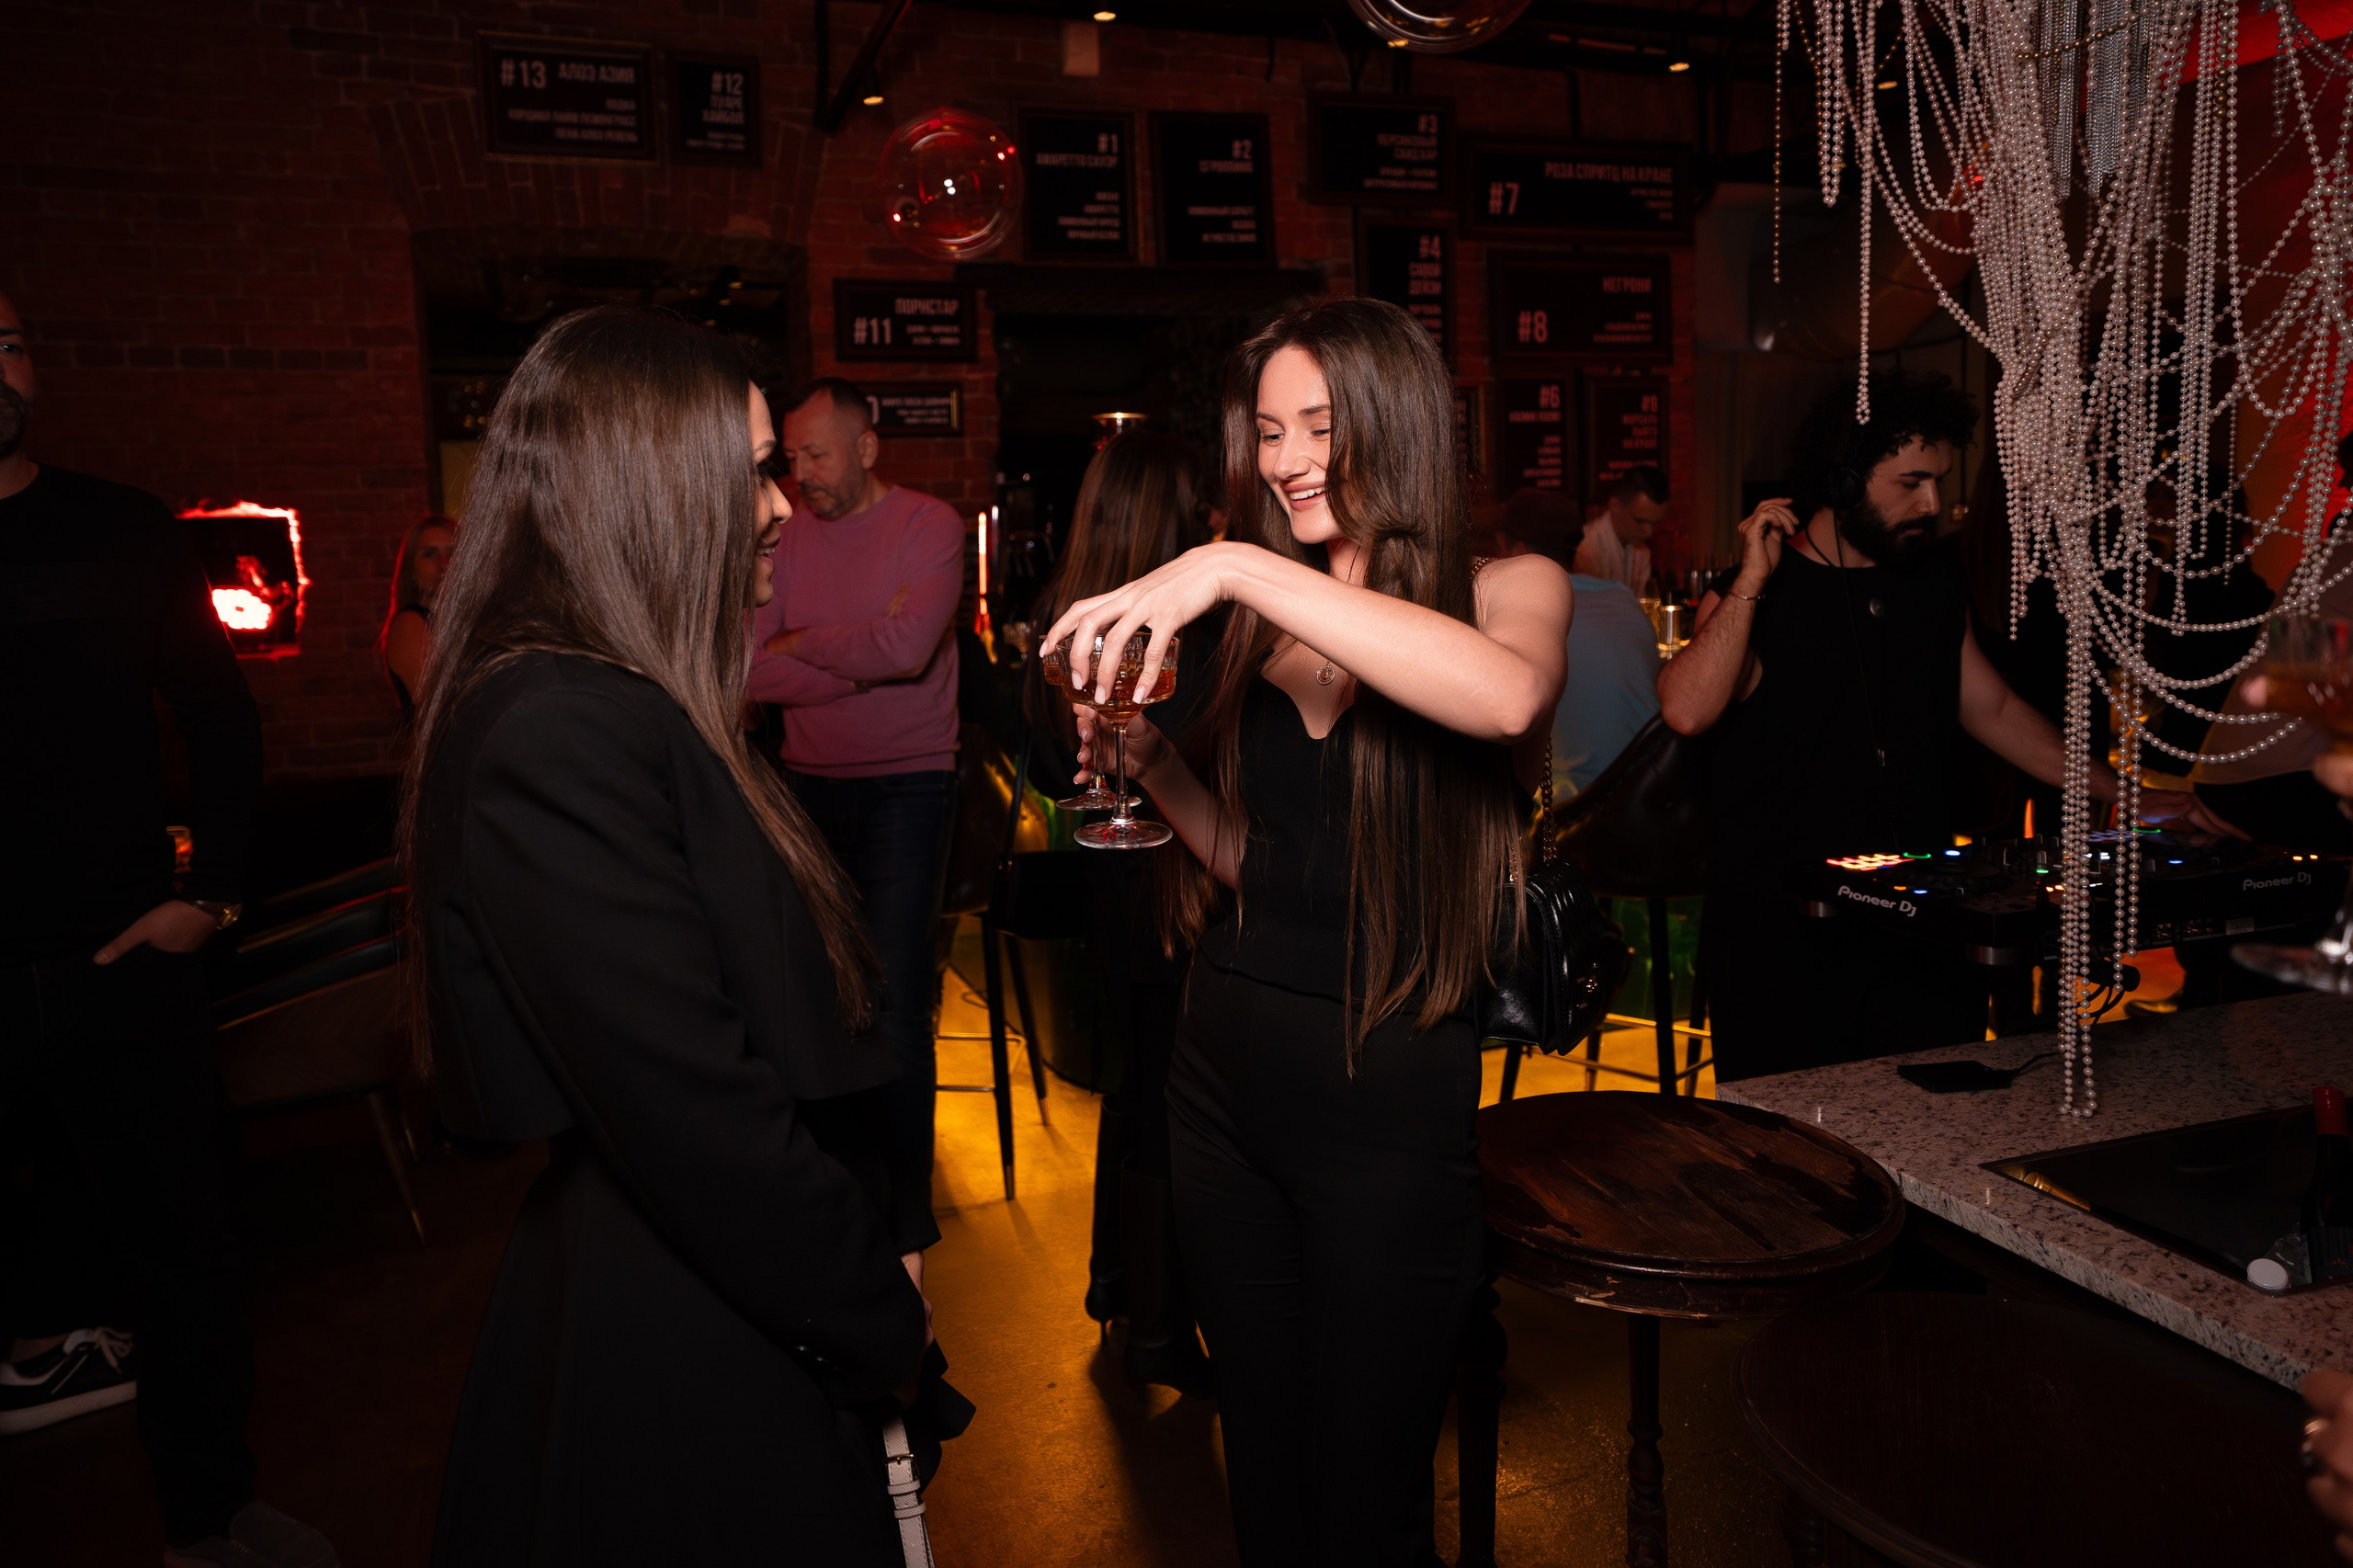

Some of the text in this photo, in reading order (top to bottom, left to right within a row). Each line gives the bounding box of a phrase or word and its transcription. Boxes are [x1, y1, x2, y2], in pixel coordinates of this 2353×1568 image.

[500, 57, 548, 89] #13
[597, 64, 637, 85] АЗИЯ
[710, 70, 745, 96] #12
[1417, 113, 1438, 134] #3
[1097, 132, 1119, 154] #1
[1231, 139, 1255, 160] #2
[1544, 161, 1574, 180] РОЗА
[1621, 165, 1636, 183] НА
[1637, 166, 1675, 185] КРАНЕ
[1488, 181, 1521, 217] #7
[1418, 233, 1442, 260] #4
[1602, 276, 1653, 294] НЕГРОНИ
[853, 316, 892, 346] #11
[1518, 309, 1549, 344] #8
[1538, 384, 1561, 409] #6
[2242, 875, 2295, 892] Pioneer
[1837, 884, 1897, 910] Pioneer
